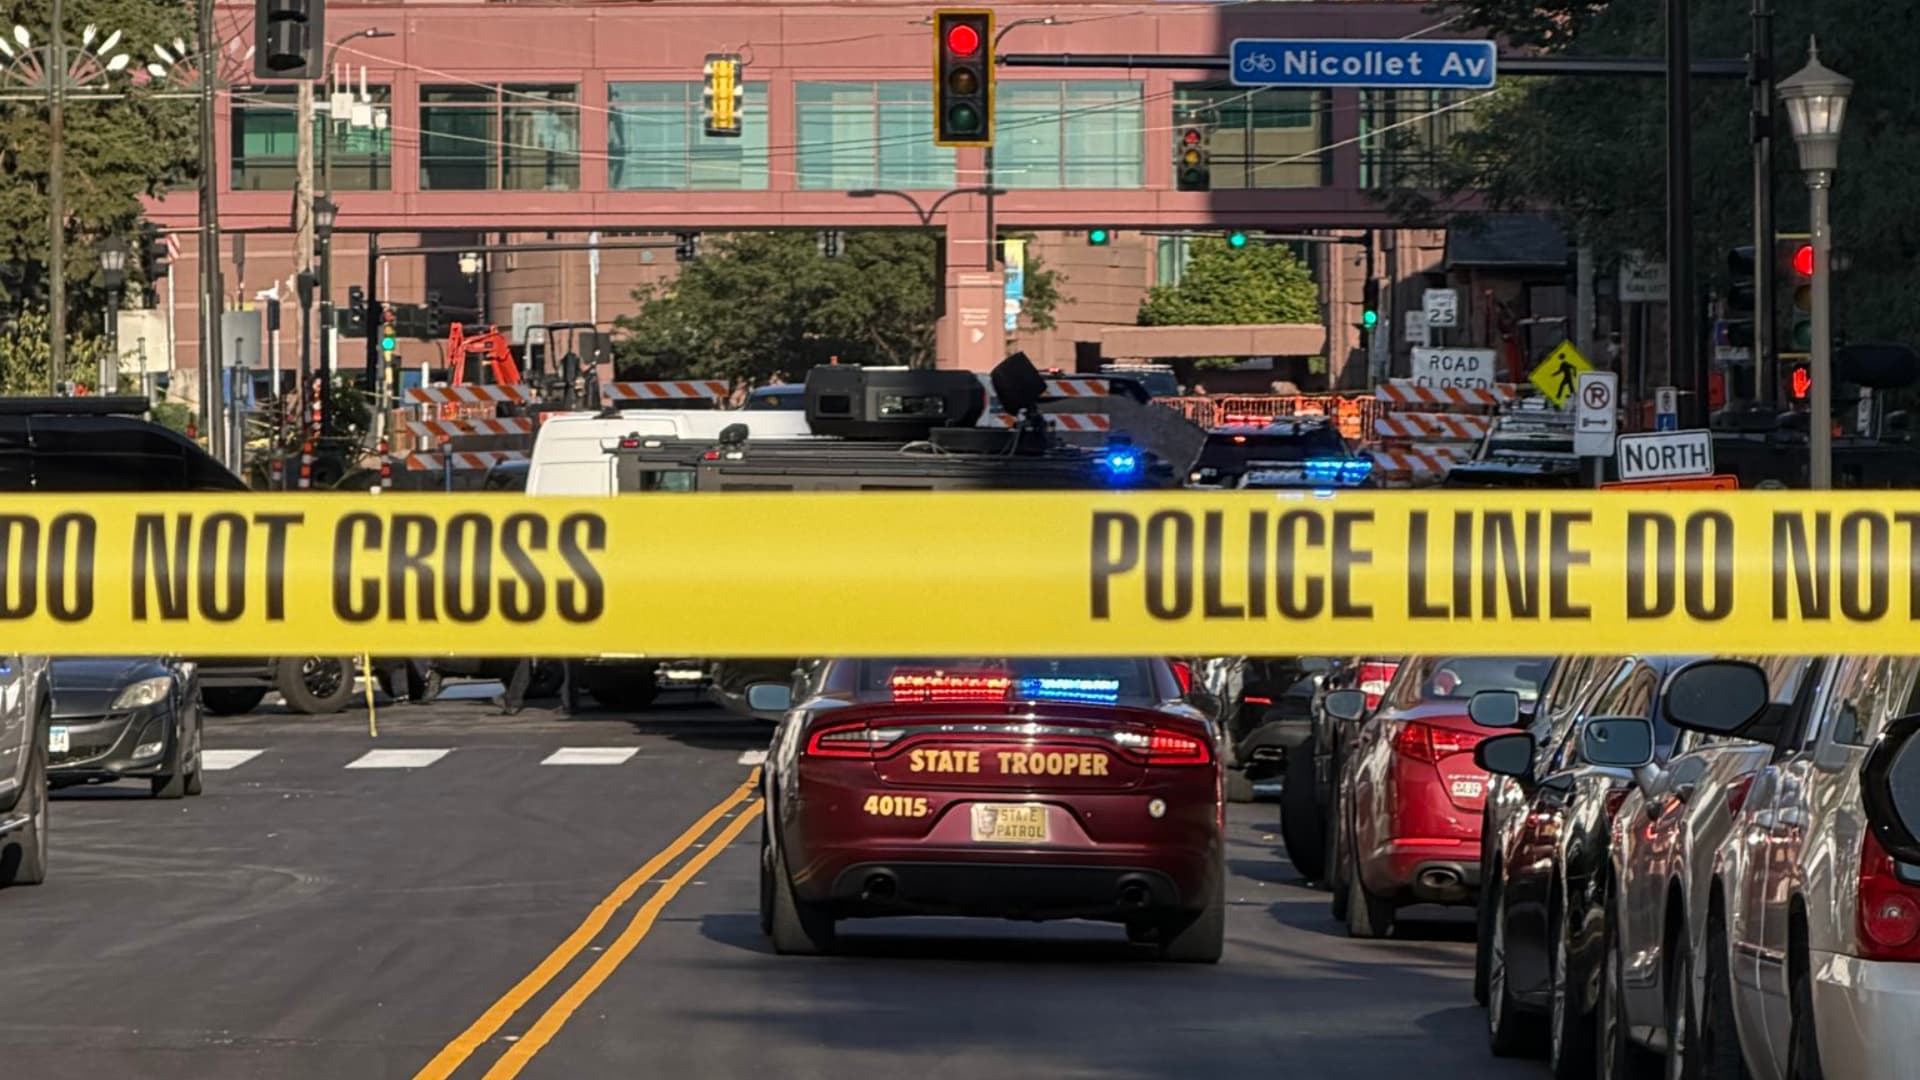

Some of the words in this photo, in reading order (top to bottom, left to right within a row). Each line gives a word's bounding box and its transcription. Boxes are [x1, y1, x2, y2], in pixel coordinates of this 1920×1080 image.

[1284, 50, 1422, 76] Nicollet
[1440, 51, 1485, 77] Av
[1430, 308, 1455, 323] 25
[1430, 355, 1480, 372] ROAD
[1625, 443, 1706, 472] NORTH
[0, 512, 96, 622] DO
[131, 512, 305, 622] NOT
[332, 512, 607, 623] CROSS
[1090, 509, 1375, 621] POLICE
[1407, 509, 1592, 621] LINE
[1626, 509, 1734, 621] DO
[910, 749, 980, 773] STATE
[997, 752, 1109, 776] TROOPER
[863, 795, 927, 817] 40115
[996, 825, 1045, 839] PATROL
